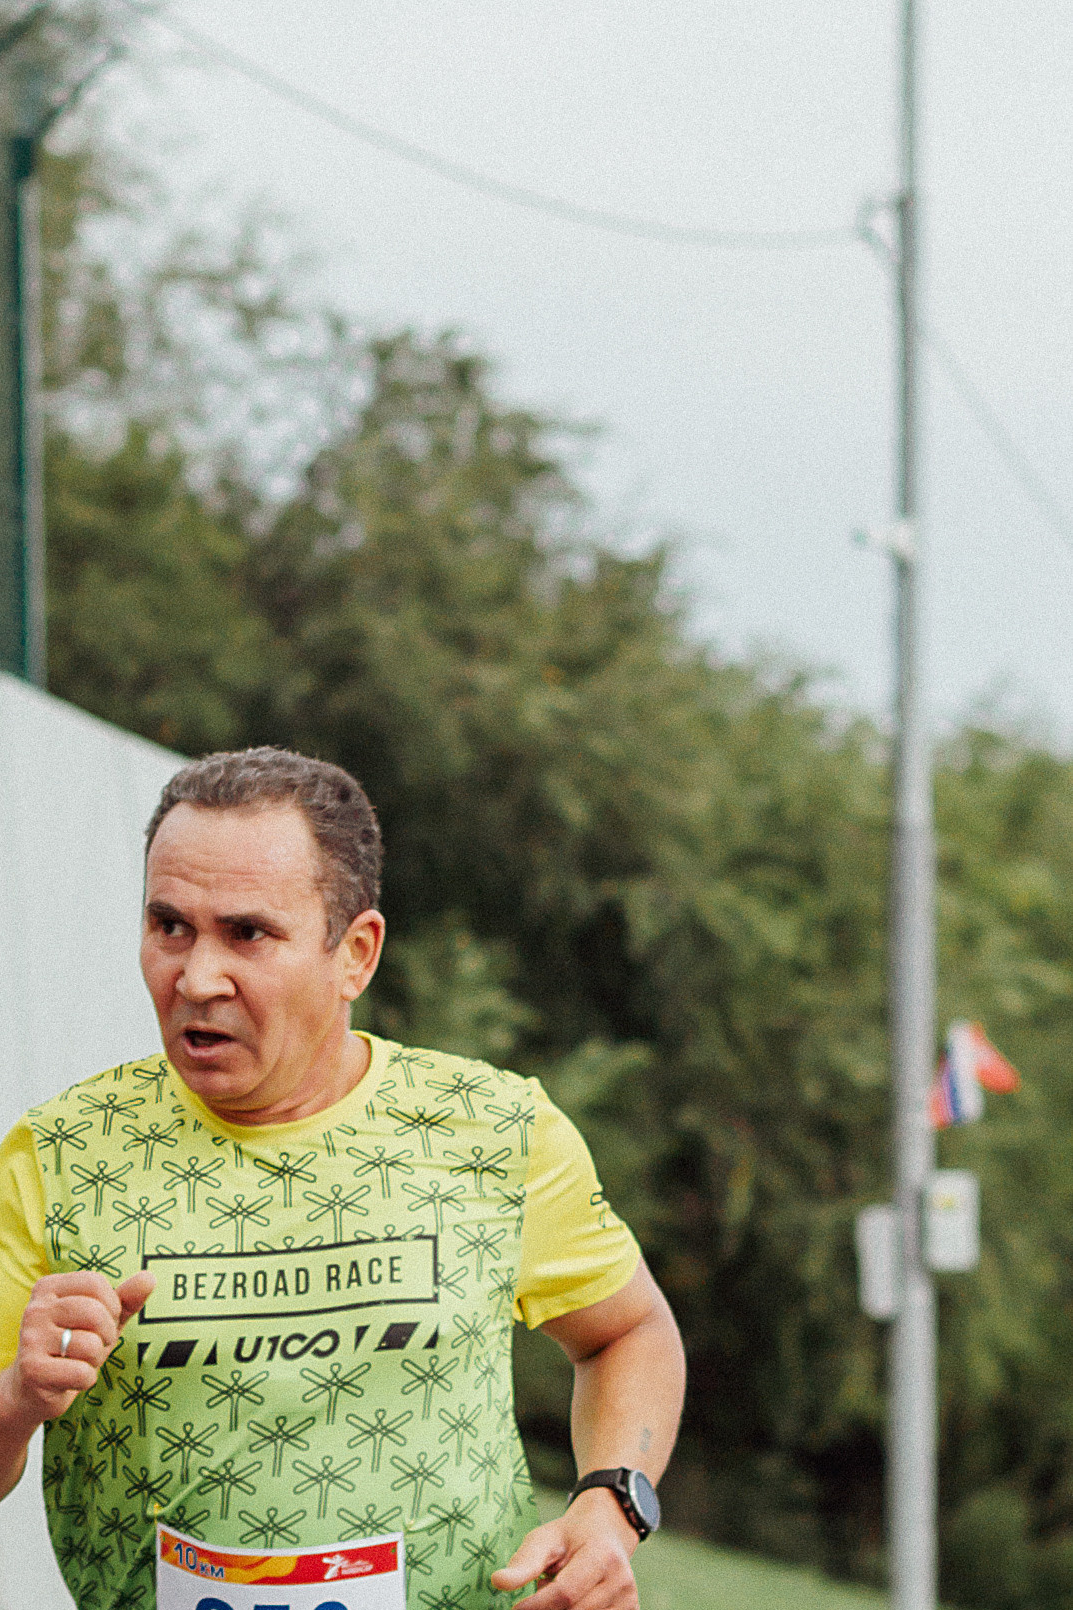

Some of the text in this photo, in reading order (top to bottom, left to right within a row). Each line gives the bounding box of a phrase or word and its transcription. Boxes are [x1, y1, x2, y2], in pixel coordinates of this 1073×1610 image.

[171, 1256, 403, 1301] BEZROAD RACE
[173, 1542, 197, 1570] 10
